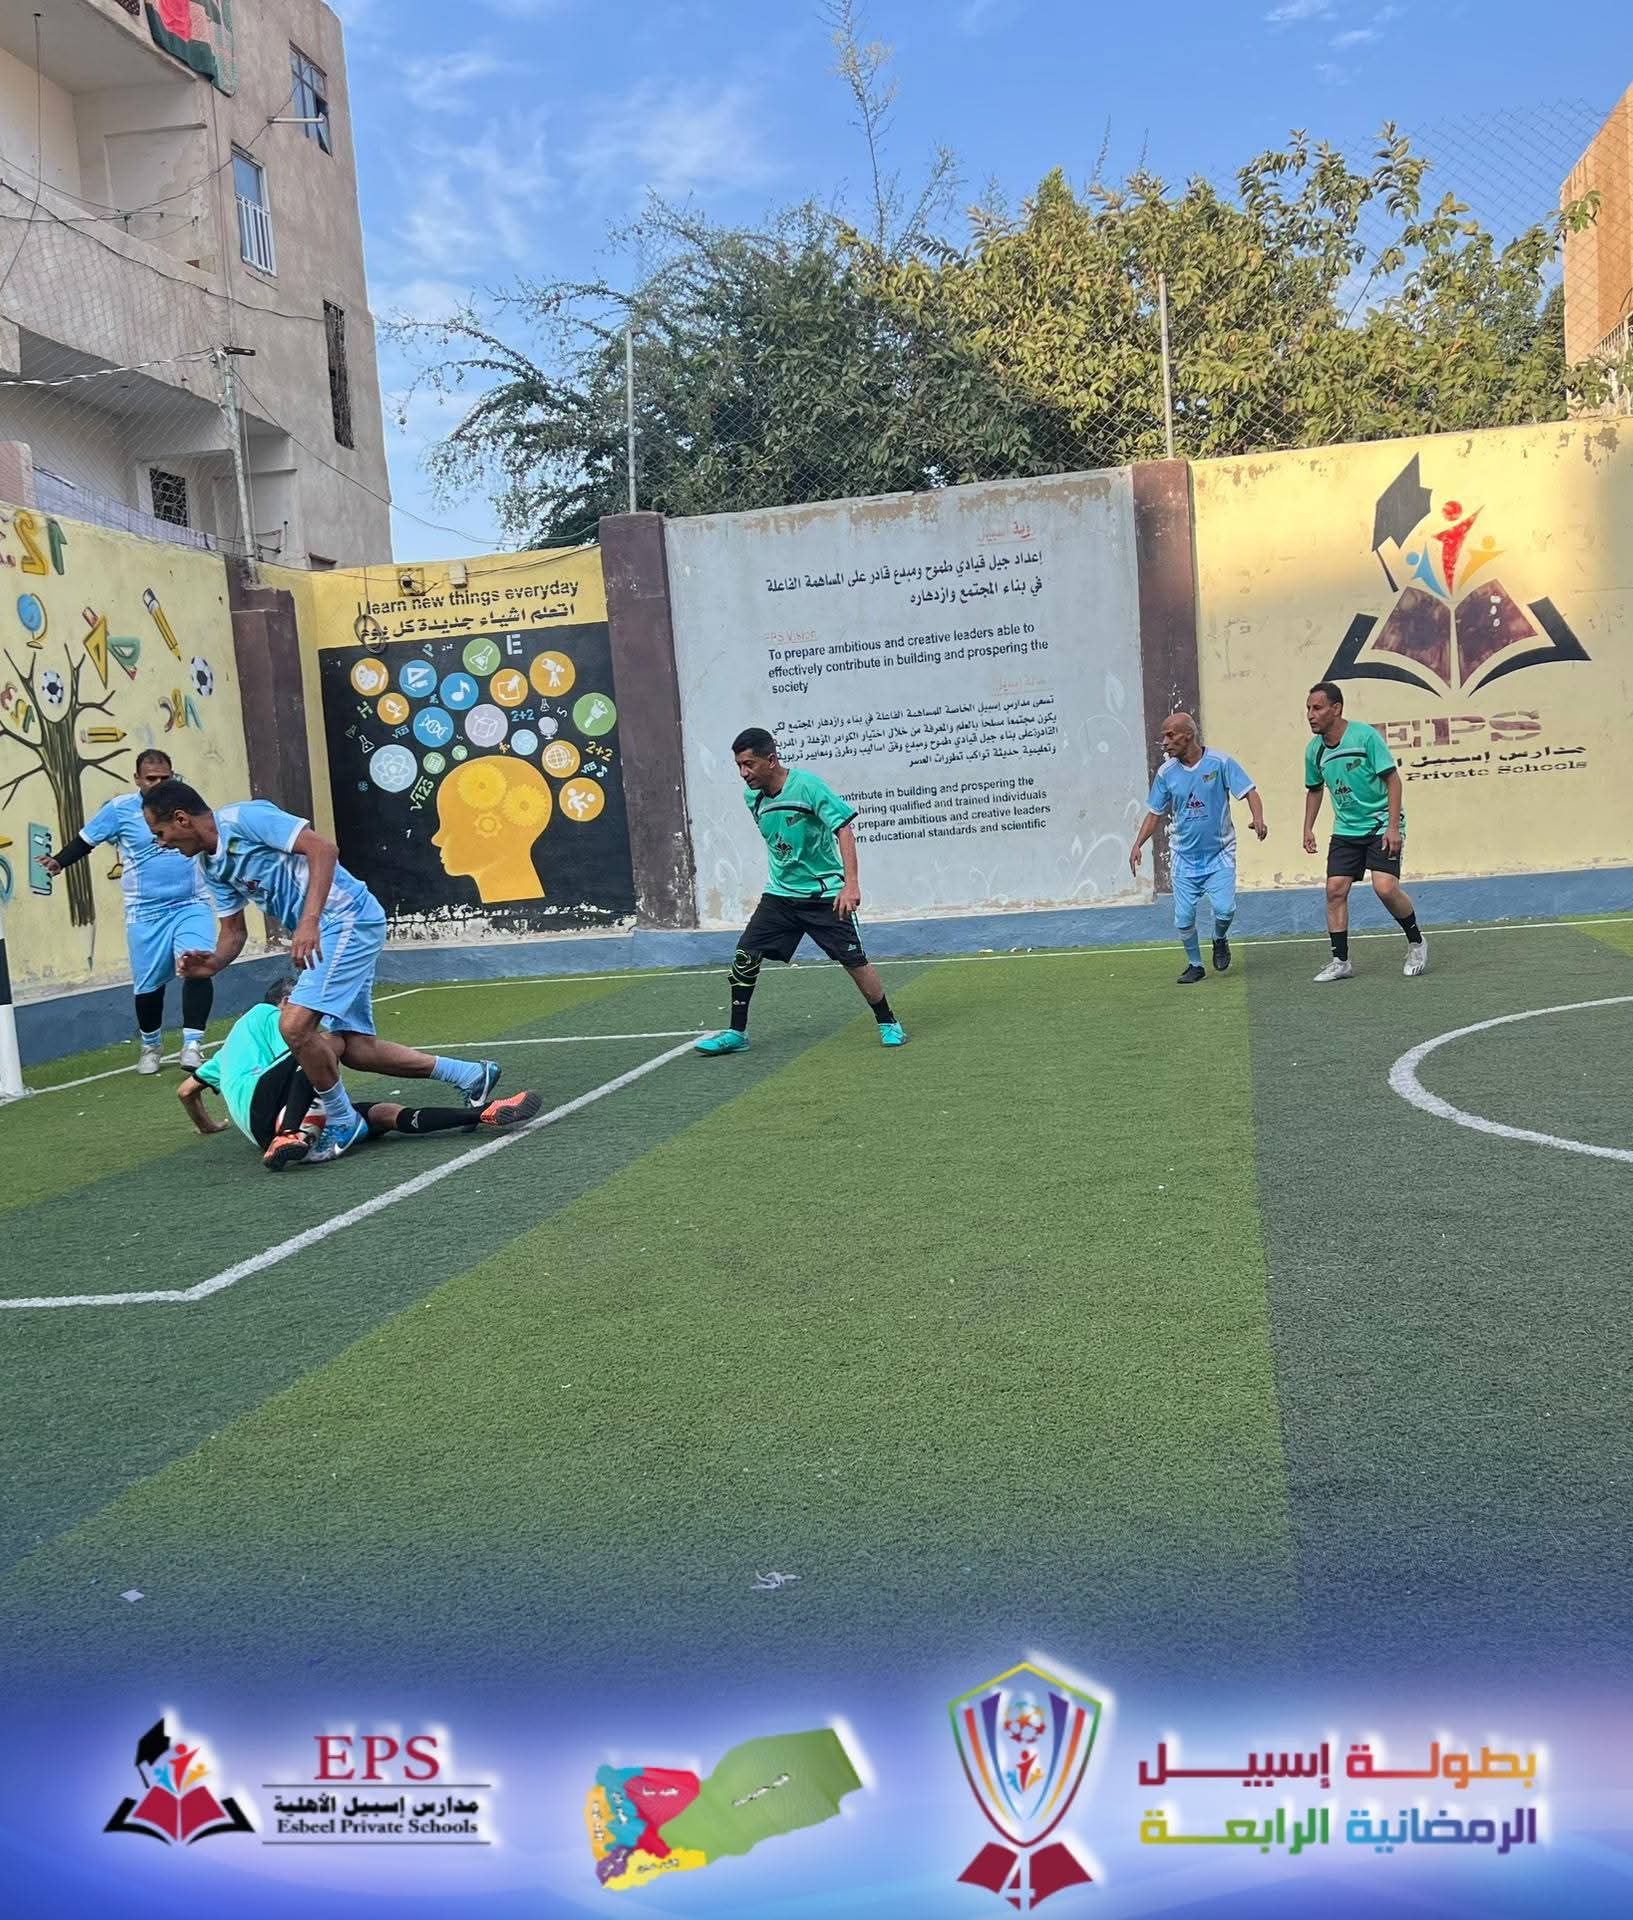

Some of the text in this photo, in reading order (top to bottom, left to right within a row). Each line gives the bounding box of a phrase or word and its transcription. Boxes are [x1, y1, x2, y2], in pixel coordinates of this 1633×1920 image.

[766, 551, 1042, 592] إعداد جيل قيادي طموح ومبدع قادر على المساهمة الفاعلة
[367, 600, 407, 615] learn
[412, 596, 444, 610] new
[449, 589, 500, 606] things
[505, 580, 579, 600] everyday
[910, 576, 1042, 606] في بناء المجتمع وازدهاره
[393, 620, 415, 637] كل
[418, 617, 474, 634] جديدة
[768, 623, 1035, 661] To prepare ambitious and creative leaders able to
[768, 639, 1048, 678] effectively contribute in building and prospering the
[772, 681, 809, 694] society
[945, 703, 974, 714] الخاصة
[1003, 700, 1030, 714] مدارس
[510, 709, 535, 722] 2+2
[847, 715, 862, 726] بناء
[865, 712, 873, 726] في
[1037, 712, 1057, 724] يكون
[788, 719, 814, 733] المجتمع
[888, 727, 908, 739] خلال
[911, 727, 921, 737] من
[956, 720, 979, 733] بالعلم
[1371, 710, 1542, 749] EPS
[834, 732, 859, 744] الكوادر
[862, 729, 885, 742] اختيار
[955, 733, 977, 748] قيادي
[980, 733, 997, 743] جيل
[1000, 730, 1016, 741] بناء
[966, 749, 990, 762] تواكب
[993, 748, 1019, 759] حديثة
[1406, 761, 1587, 782] Private Schools
[886, 788, 894, 798] in
[897, 786, 937, 796] building
[940, 782, 958, 793] and
[961, 778, 1015, 793] prospering
[1018, 777, 1034, 786] the
[859, 790, 1047, 815] hiring qualified and trained individuals
[858, 818, 896, 831] prepare
[898, 813, 947, 826] ambitious
[950, 810, 968, 821] and
[971, 807, 1011, 819] creative
[1014, 805, 1051, 815] leaders
[869, 829, 925, 842] educational
[928, 824, 977, 838] standards
[980, 823, 998, 833] and
[1001, 818, 1046, 832] scientific
